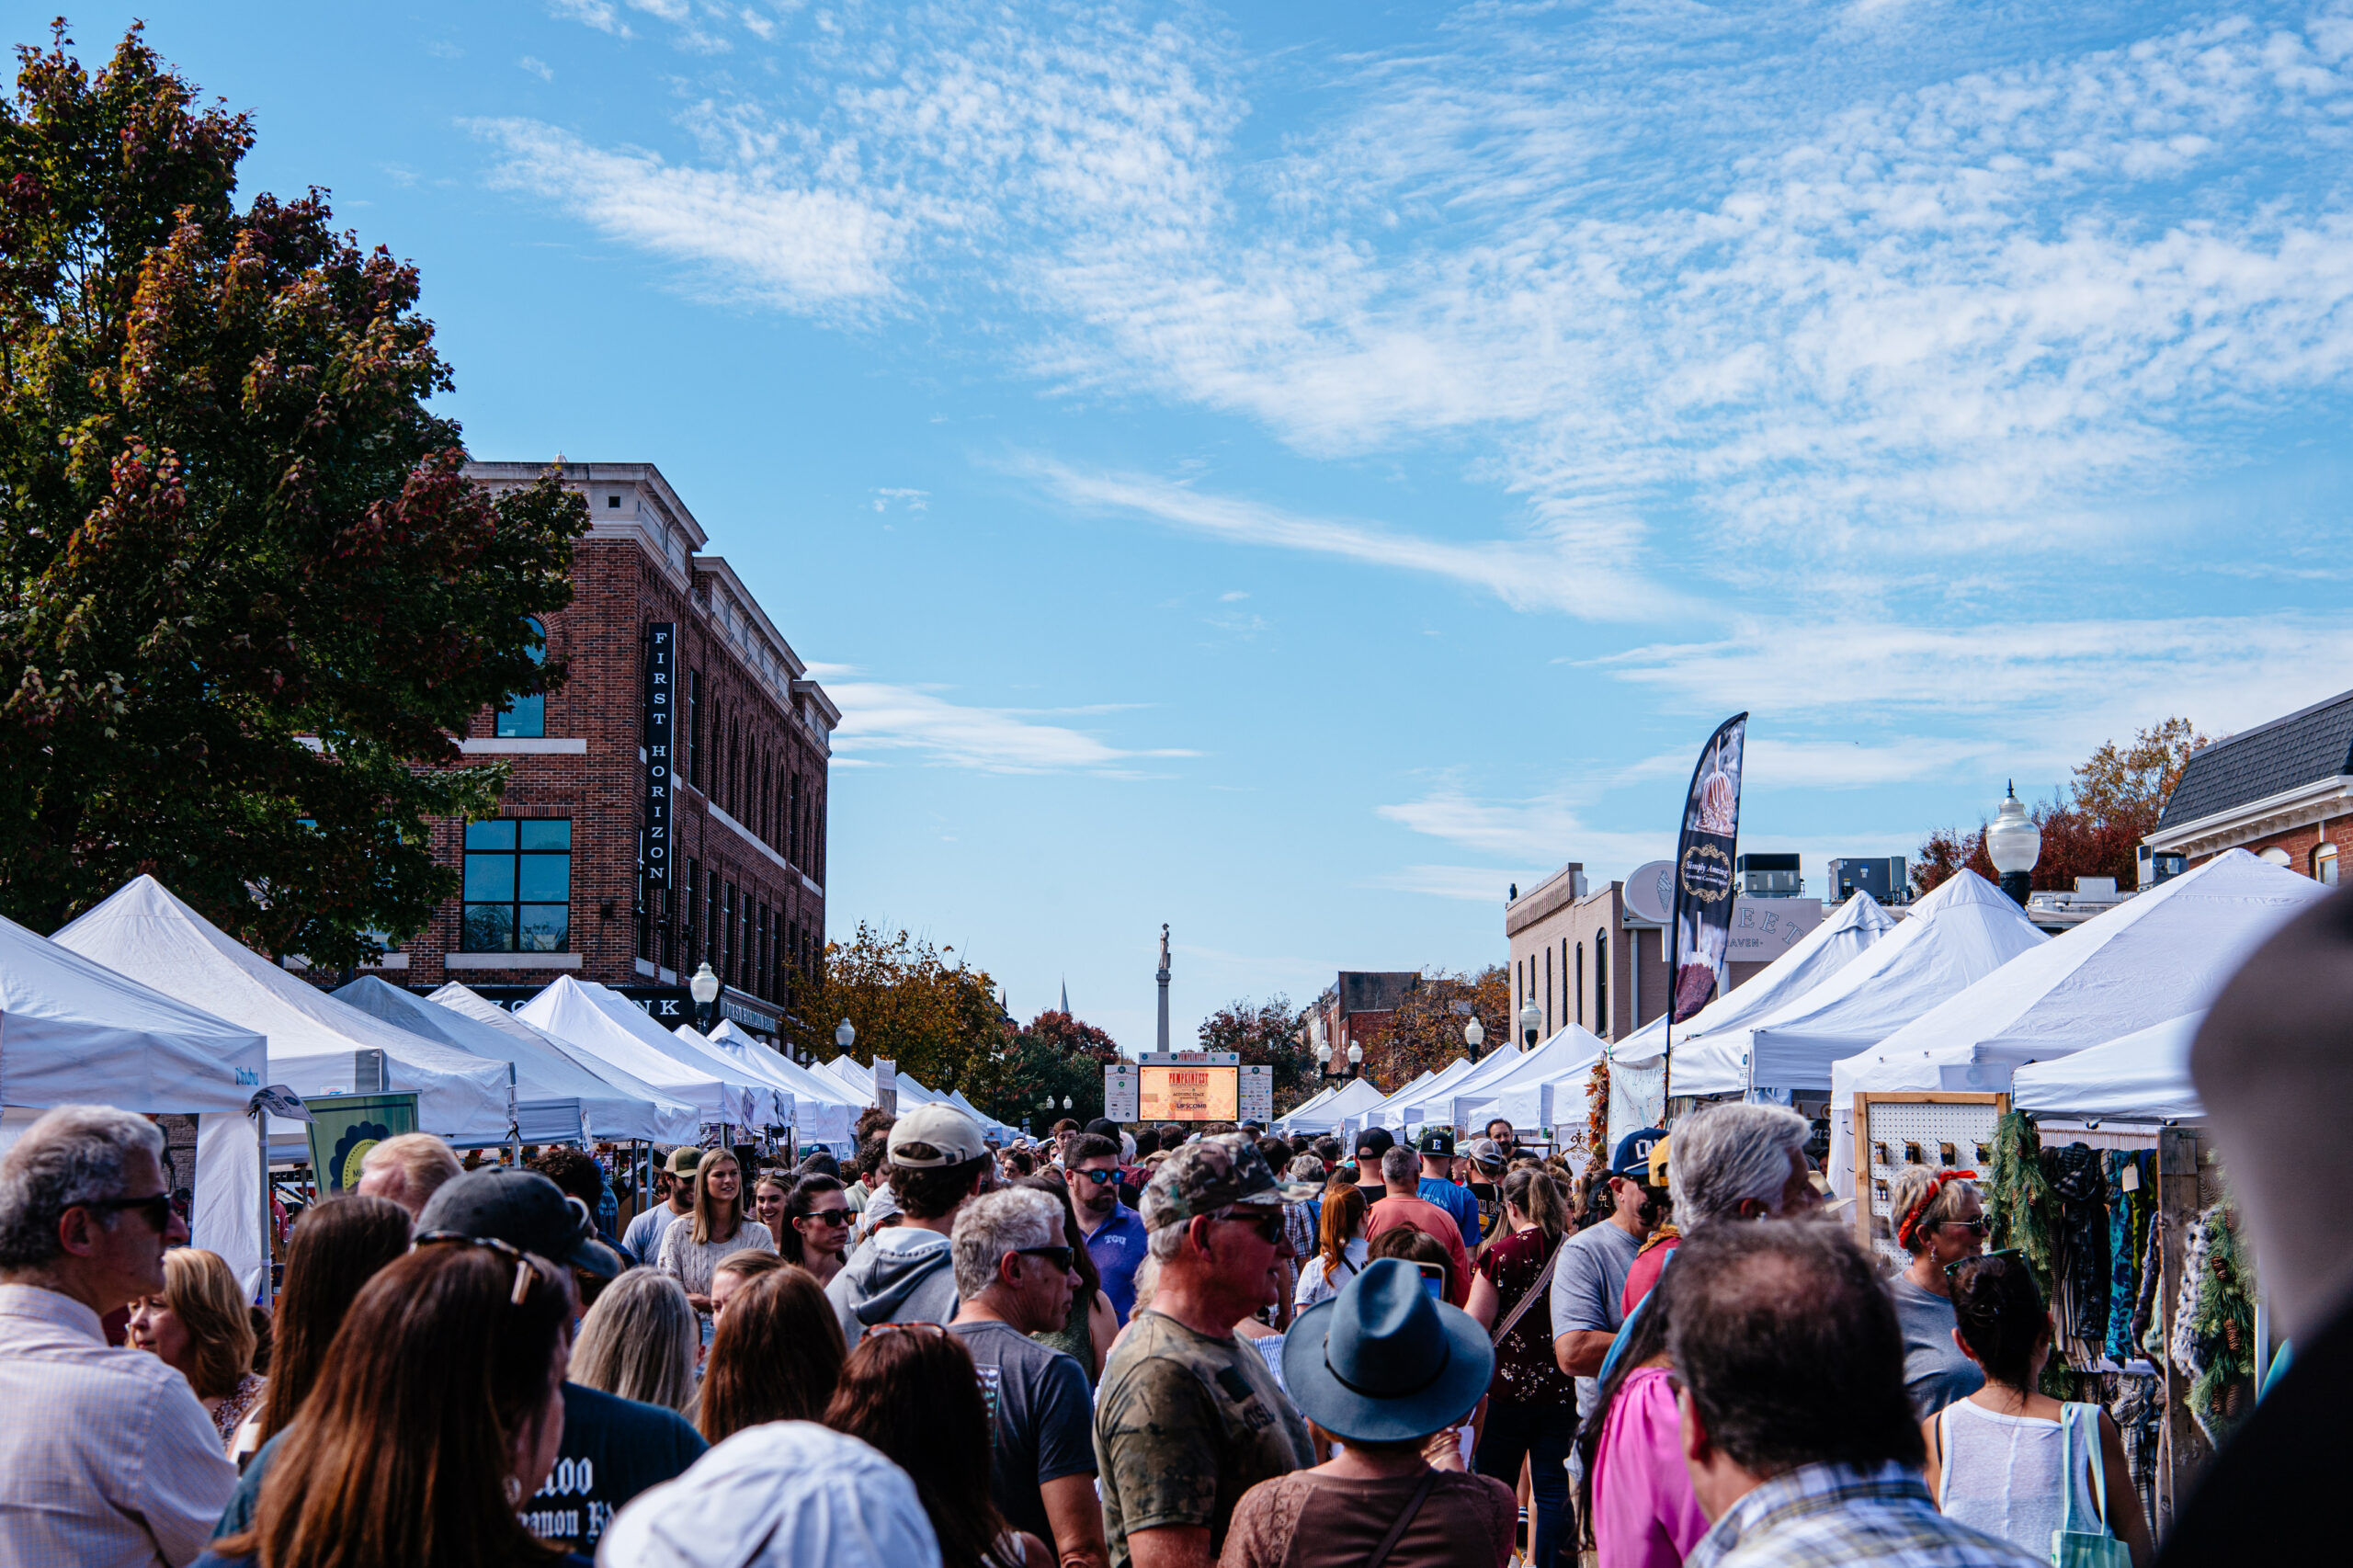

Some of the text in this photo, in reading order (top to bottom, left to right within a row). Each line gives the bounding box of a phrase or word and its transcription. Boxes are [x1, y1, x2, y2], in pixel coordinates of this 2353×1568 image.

[649, 632, 667, 879] FIRST HORIZON
[1686, 860, 1706, 873] Simply
[1737, 907, 1803, 945] EET
[634, 1000, 680, 1015] NK
[1168, 1073, 1209, 1084] PUMPKINFEST
[1432, 1139, 1442, 1151] E
